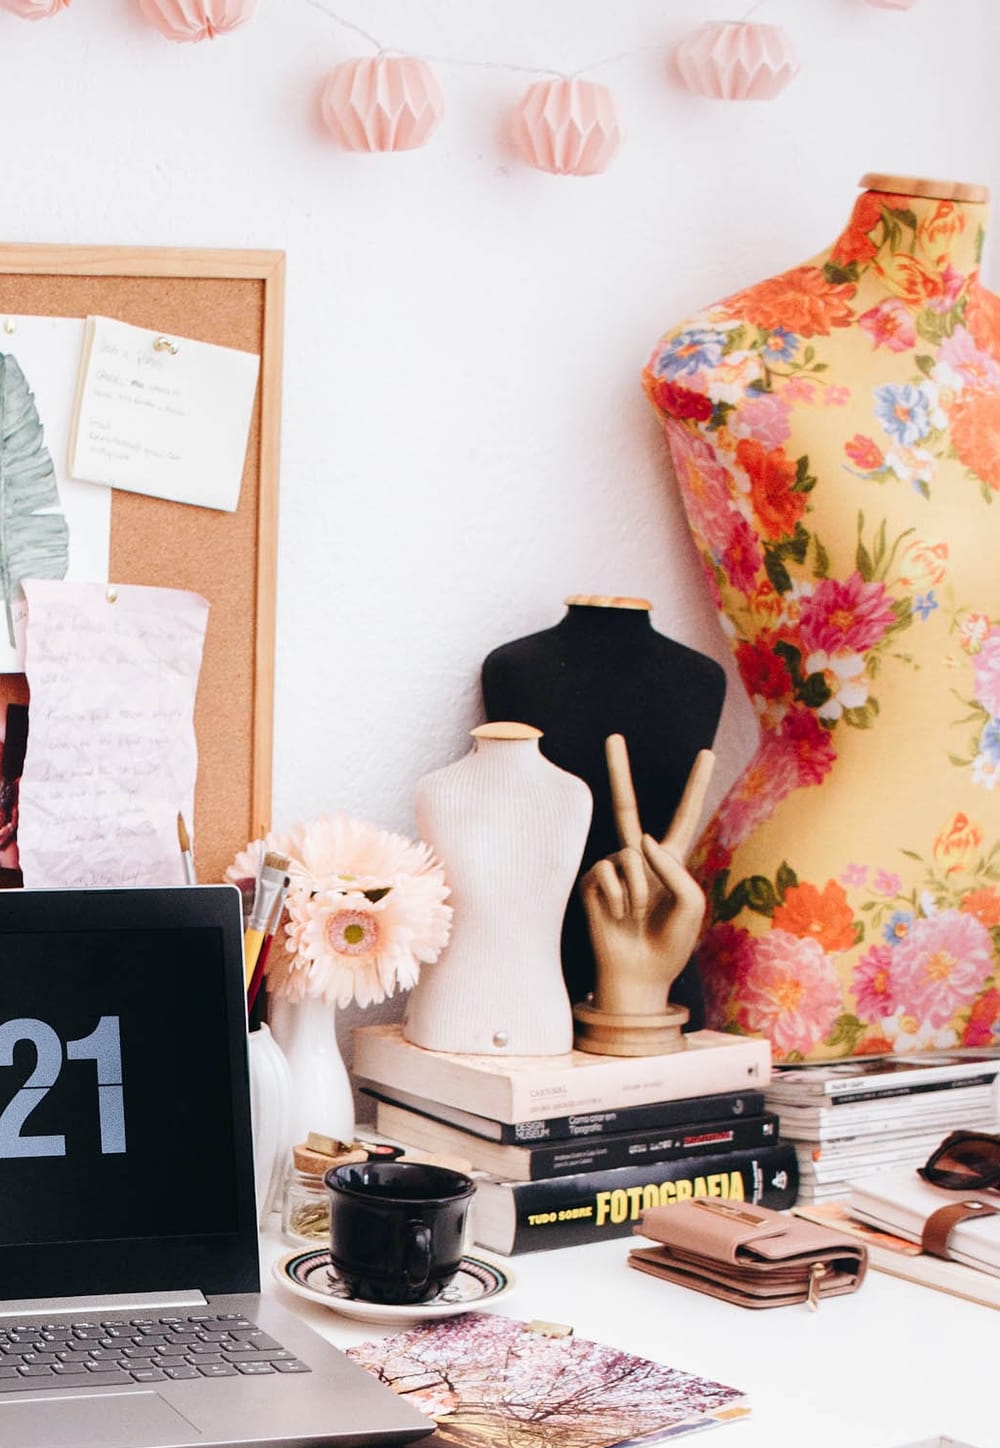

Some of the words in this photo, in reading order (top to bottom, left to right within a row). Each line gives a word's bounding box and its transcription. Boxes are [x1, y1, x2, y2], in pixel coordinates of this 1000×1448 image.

[515, 1120, 545, 1131] DESIGN
[515, 1128, 550, 1140] MUSEUM
[528, 1212, 557, 1226] TUDO
[558, 1206, 593, 1221] SOBRE
